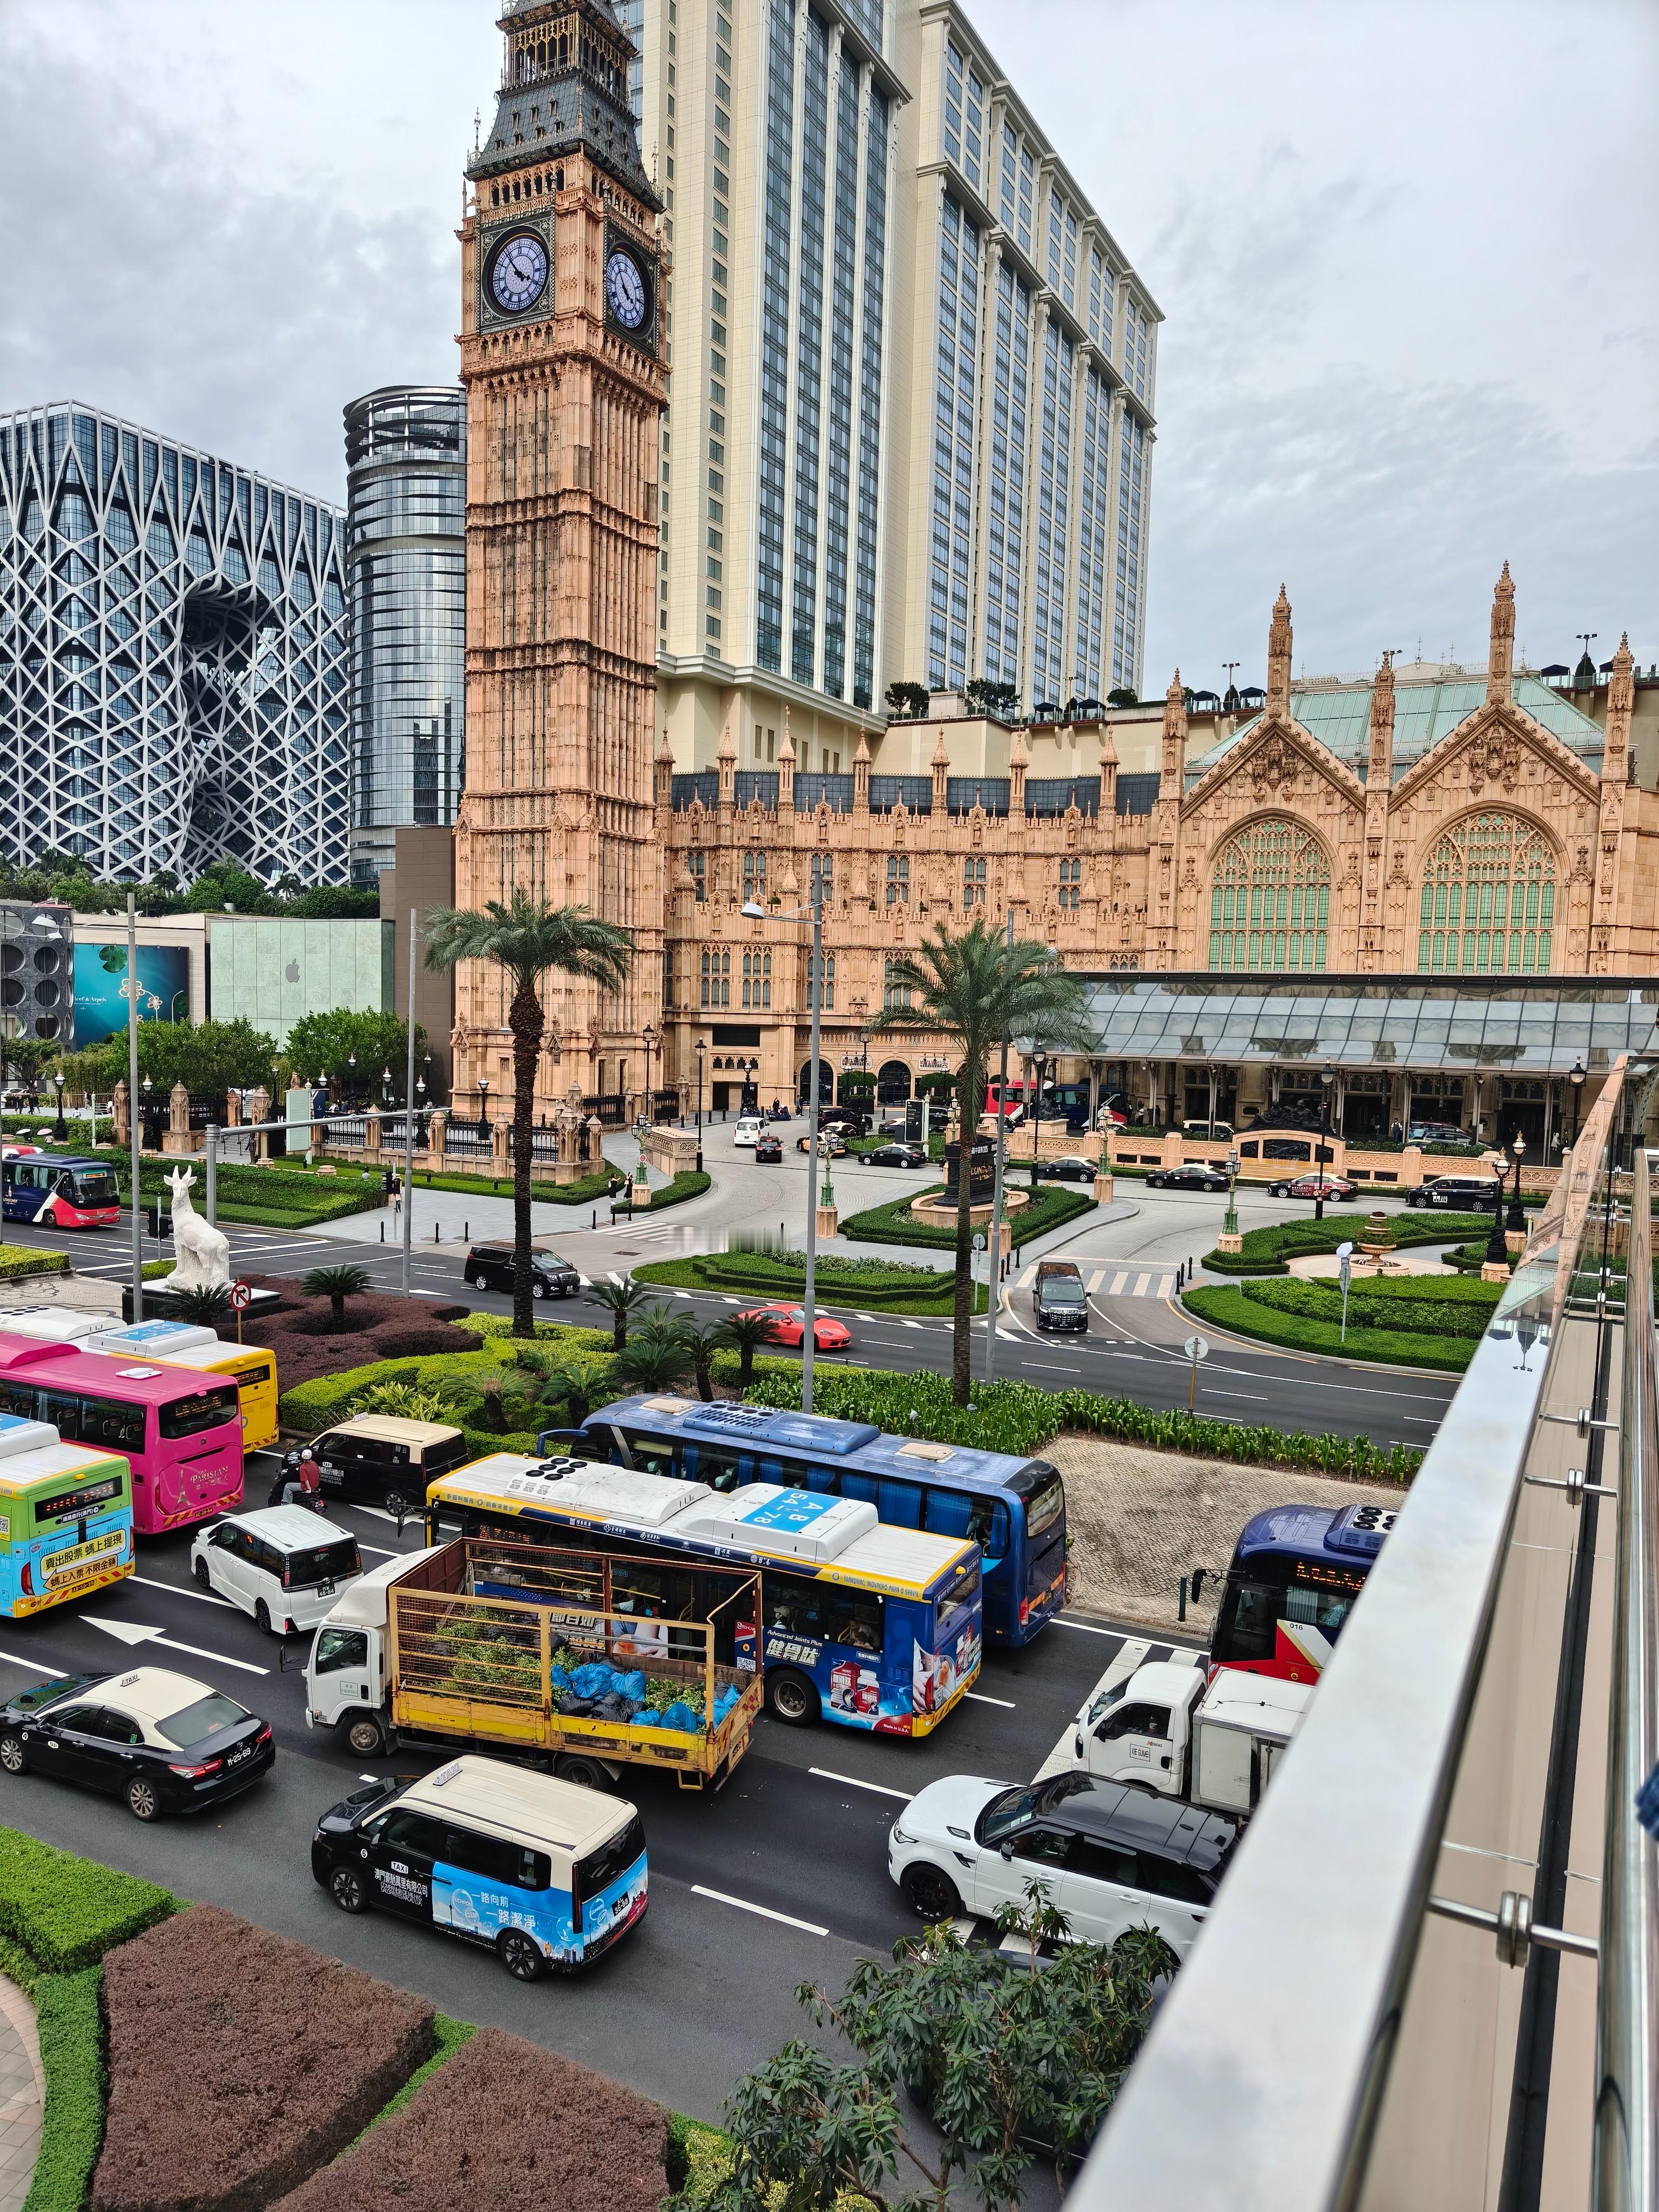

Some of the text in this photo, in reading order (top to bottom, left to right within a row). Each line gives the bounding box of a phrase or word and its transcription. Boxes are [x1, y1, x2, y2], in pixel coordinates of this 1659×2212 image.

[190, 1465, 228, 1485] PARISIAN
[753, 1493, 809, 1524] 54-78
[85, 1533, 122, 1556] 螞上提現
[85, 1556, 117, 1575] 不限金額
[767, 1629, 794, 1641] Advanced
[793, 1635, 811, 1644] Joints
[125, 1674, 138, 1684] TAXI
[227, 1747, 251, 1767] M-25-69
[393, 1862, 408, 1873] TAXI
[453, 1896, 473, 1907] TECHRON
[471, 1892, 509, 1908] 一路向前
[615, 1898, 629, 1914] 95-88
[485, 1909, 536, 1930] 一路潔淨
